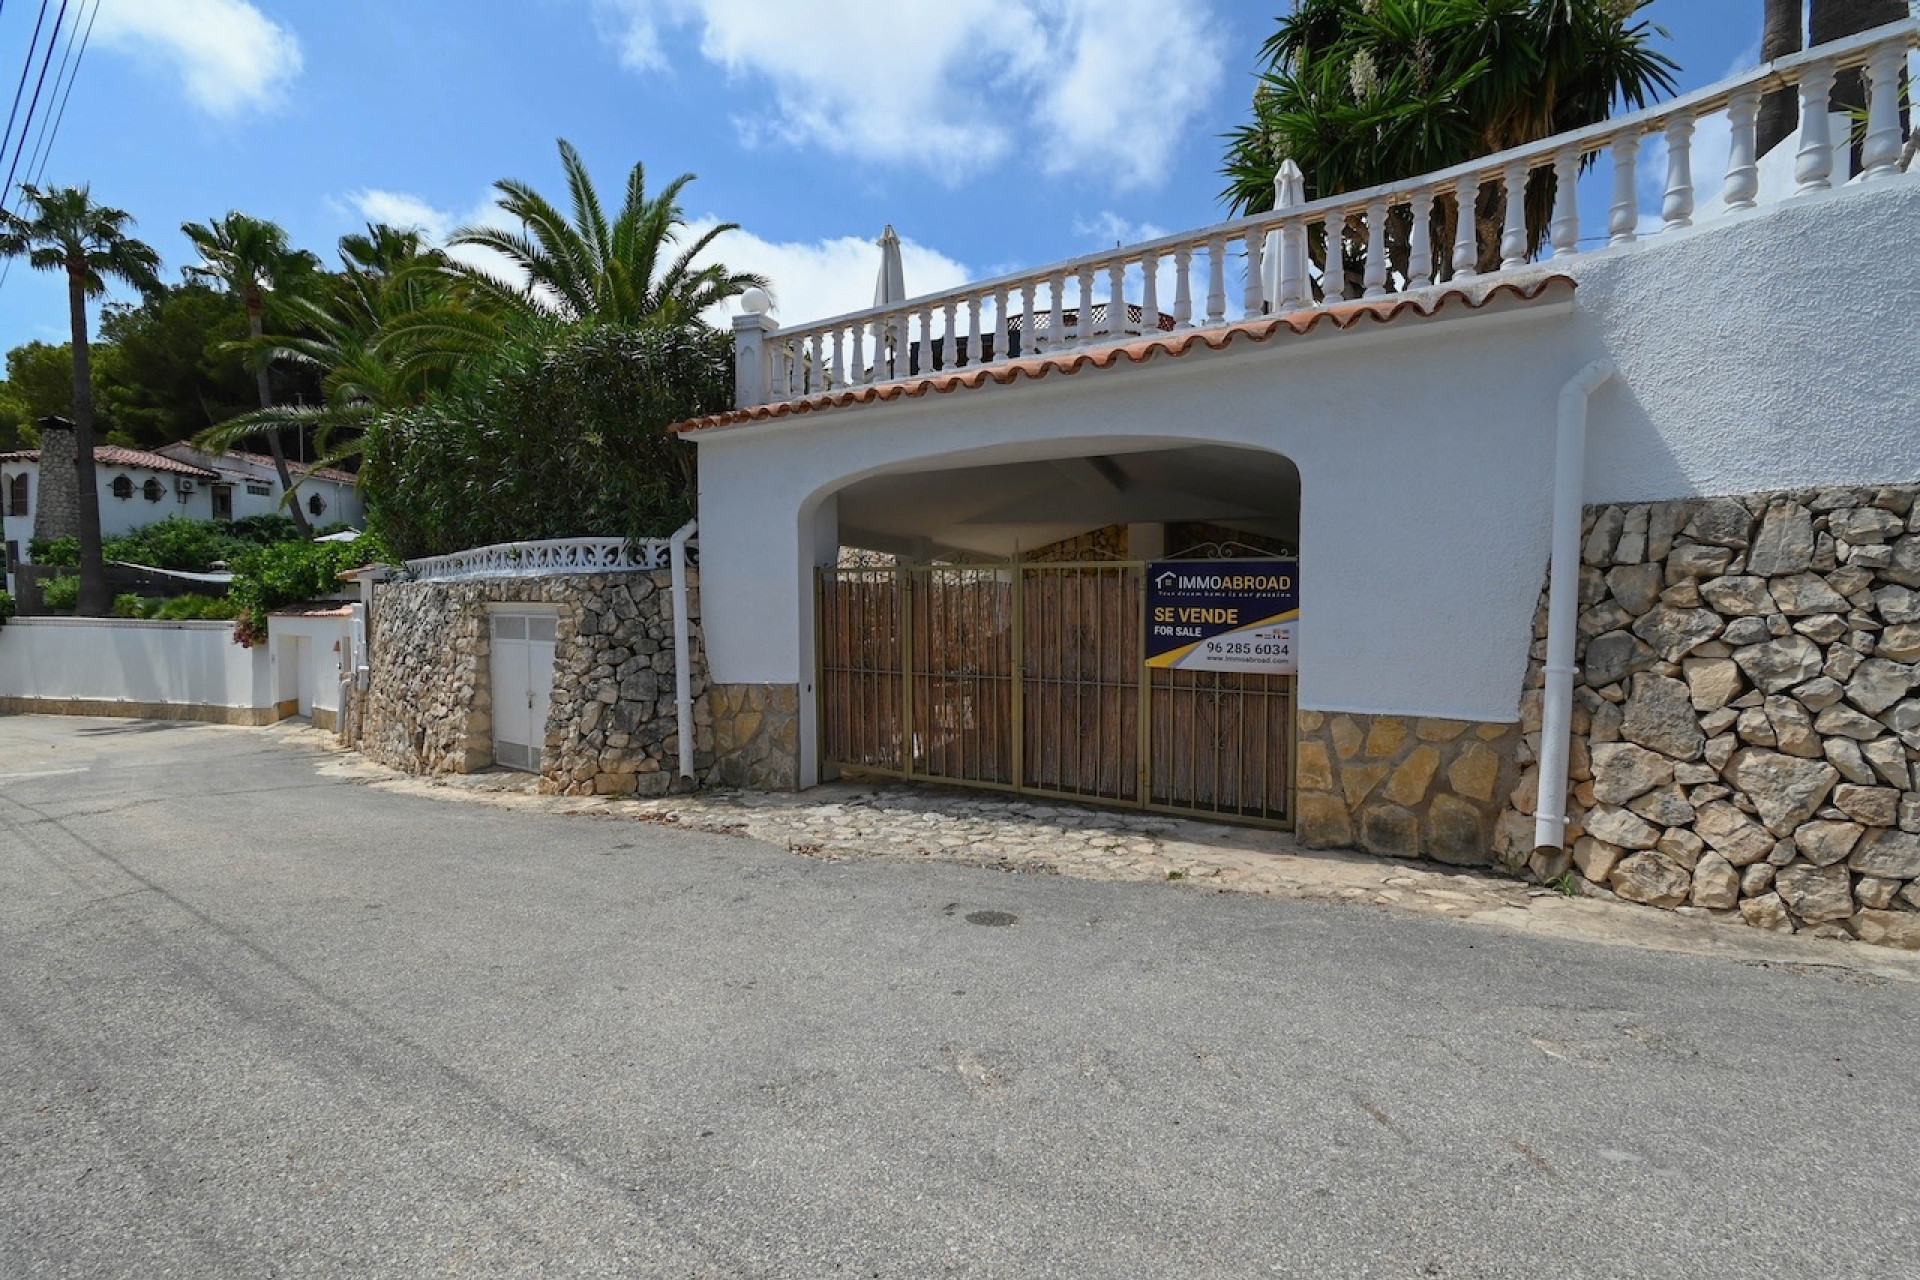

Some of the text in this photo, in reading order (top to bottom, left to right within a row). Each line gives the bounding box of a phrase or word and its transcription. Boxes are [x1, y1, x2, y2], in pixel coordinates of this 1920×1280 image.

[1178, 575, 1291, 590] IMMOABROAD
[1204, 590, 1225, 598] home
[1154, 607, 1239, 625] SE VENDE
[1154, 625, 1202, 637] FOR SALE
[1206, 641, 1290, 656] 96 285 6034
[1206, 655, 1290, 664] www.immoabroad.com
